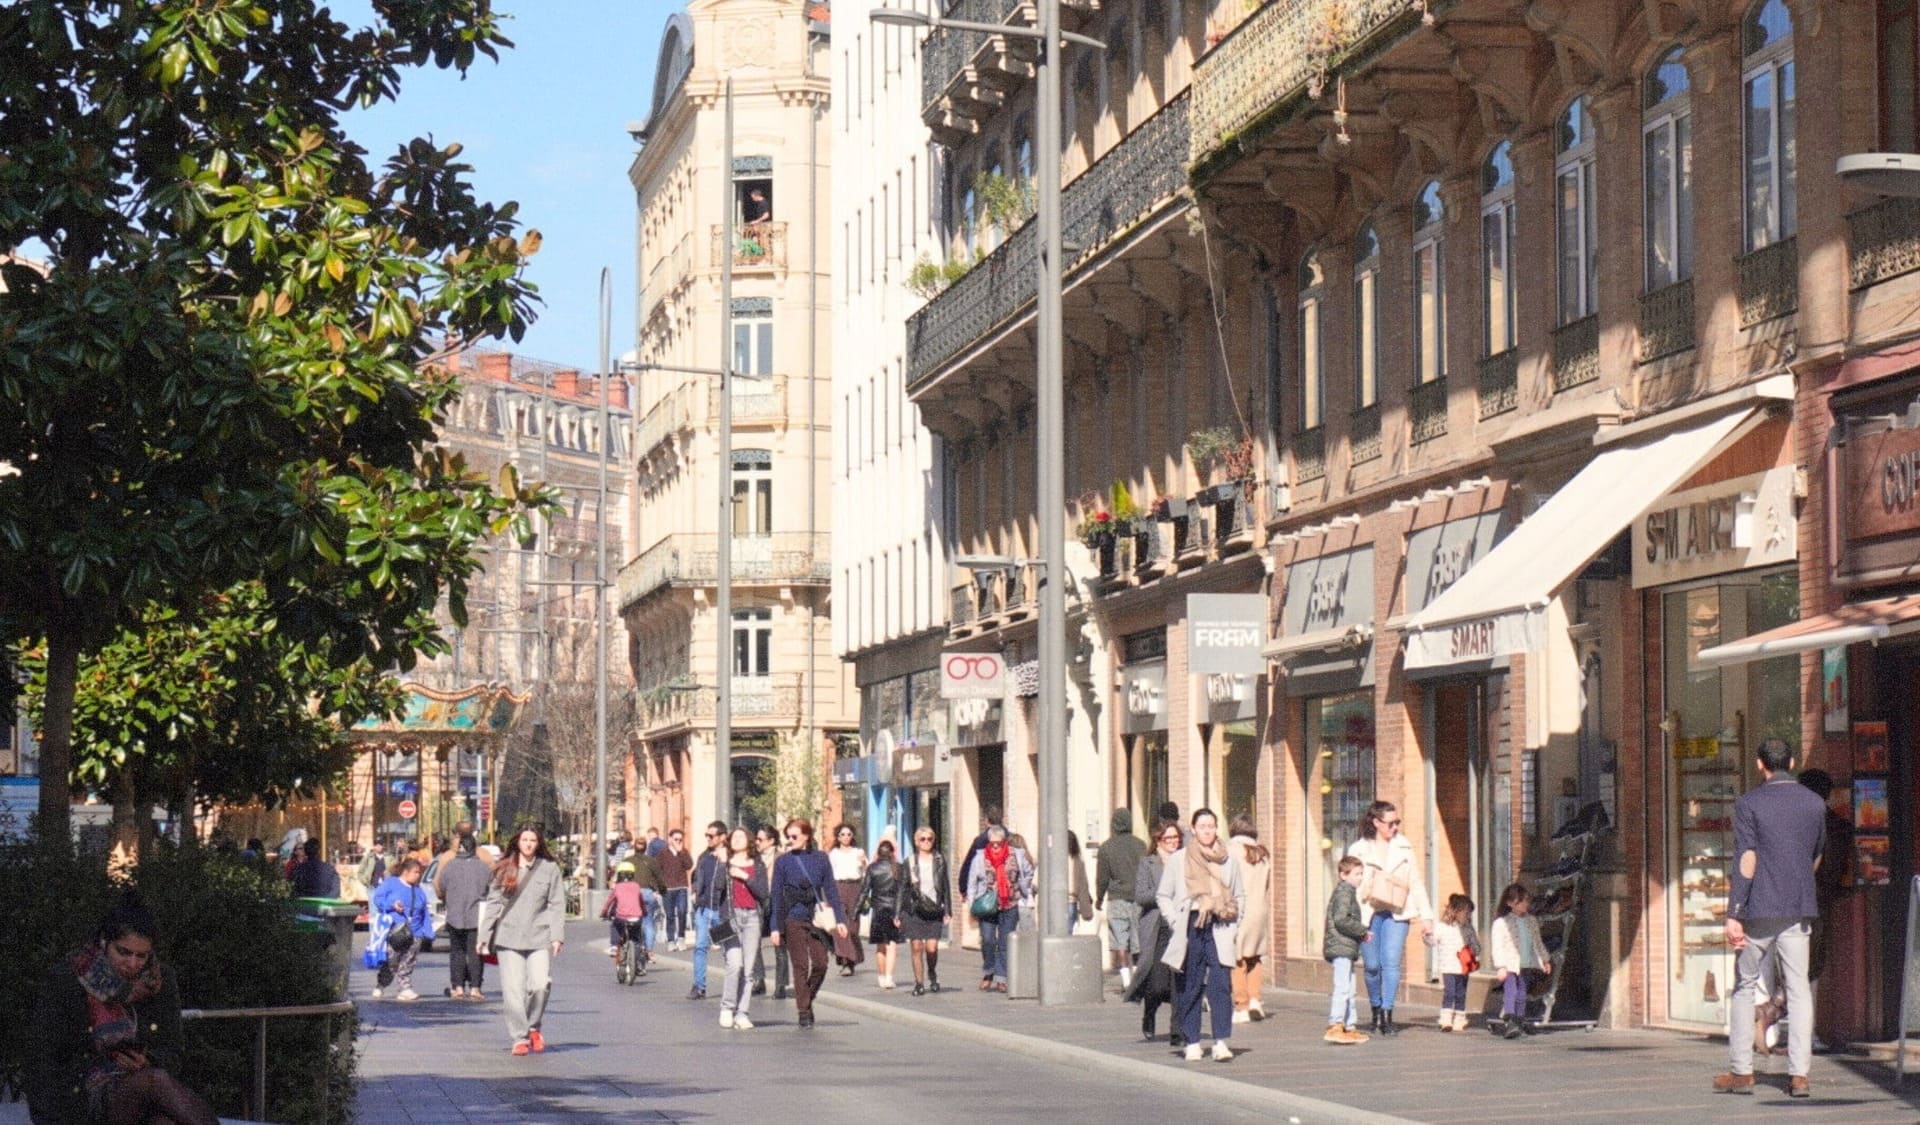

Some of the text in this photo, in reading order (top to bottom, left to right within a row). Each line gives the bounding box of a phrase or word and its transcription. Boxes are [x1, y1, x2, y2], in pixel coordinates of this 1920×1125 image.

[1645, 494, 1741, 564] SMART
[1195, 628, 1261, 647] FRAM
[1451, 621, 1496, 658] SMART
